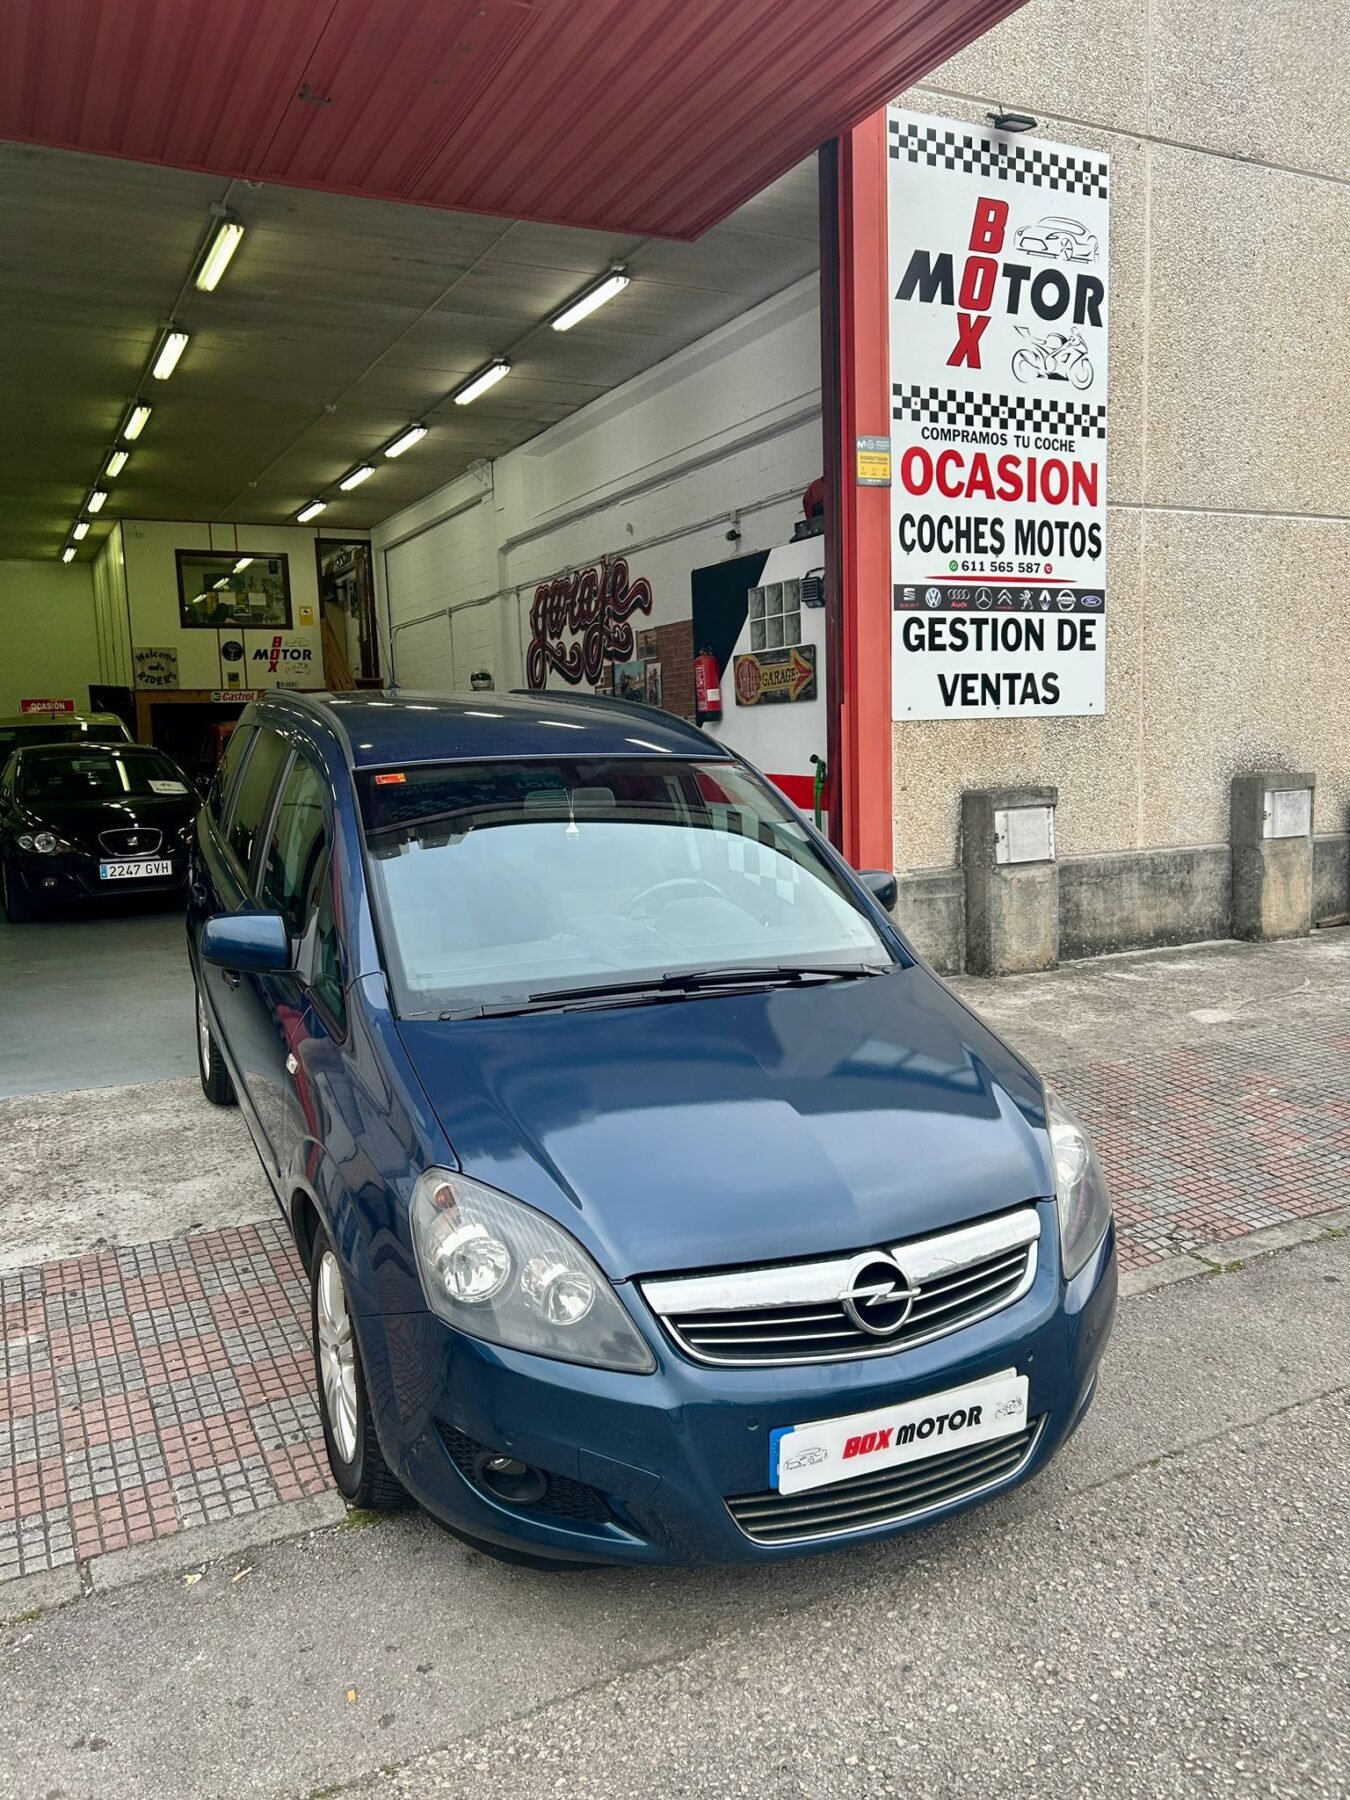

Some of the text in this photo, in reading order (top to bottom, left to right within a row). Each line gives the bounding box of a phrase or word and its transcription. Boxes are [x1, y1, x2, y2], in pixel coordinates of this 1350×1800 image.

[895, 250, 1105, 328] MOTOR
[946, 197, 1009, 370] BOX
[921, 426, 1076, 453] COMPRAMOS TU COCHE
[900, 446, 1098, 507] OCASION
[899, 513, 1102, 560] COCHES MOTOS
[961, 561, 1041, 574] 611 565 587
[903, 617, 1097, 652] GESTION DE
[136, 649, 177, 662] Welcome
[253, 649, 312, 661] MOTOR
[762, 668, 796, 686] GARAGE
[937, 672, 1060, 706] VENTAS
[222, 691, 255, 702] Castrol
[109, 862, 169, 877] 2247 GVH
[842, 1405, 983, 1459] BOX MOTOR
